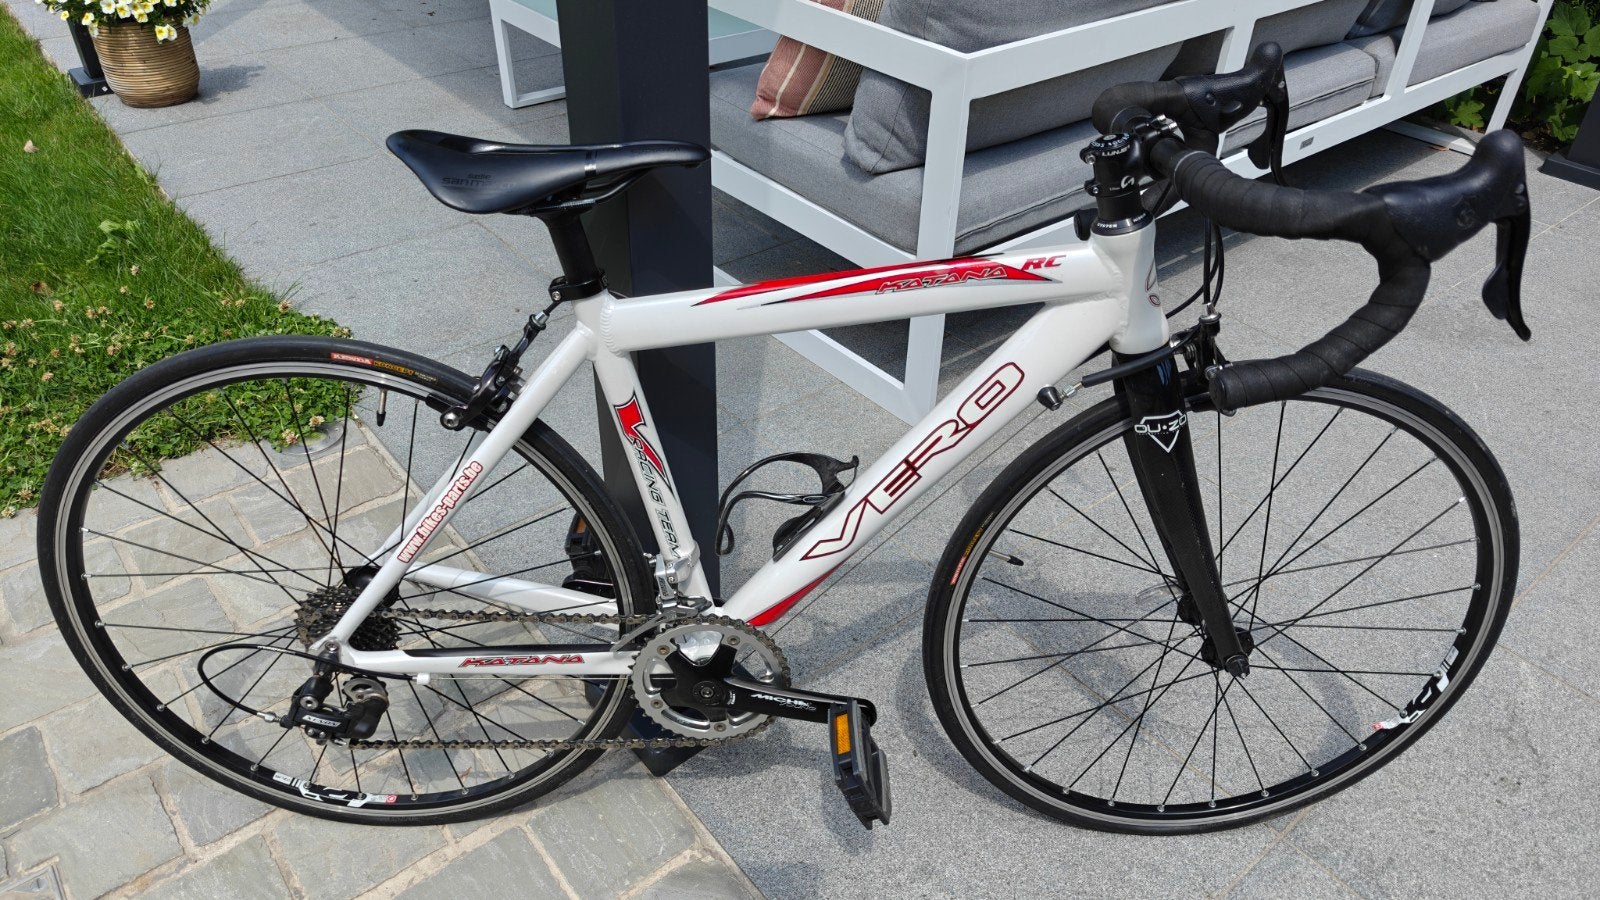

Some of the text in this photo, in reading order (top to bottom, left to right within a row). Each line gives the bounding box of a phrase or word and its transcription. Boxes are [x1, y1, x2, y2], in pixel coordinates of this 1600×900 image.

[875, 254, 1067, 295] KATANA RC
[397, 460, 483, 564] www.bikes-parts.be
[628, 433, 667, 508] RACING
[654, 508, 682, 559] TEAM
[799, 361, 1025, 561] VERO
[457, 653, 586, 668] KATANA
